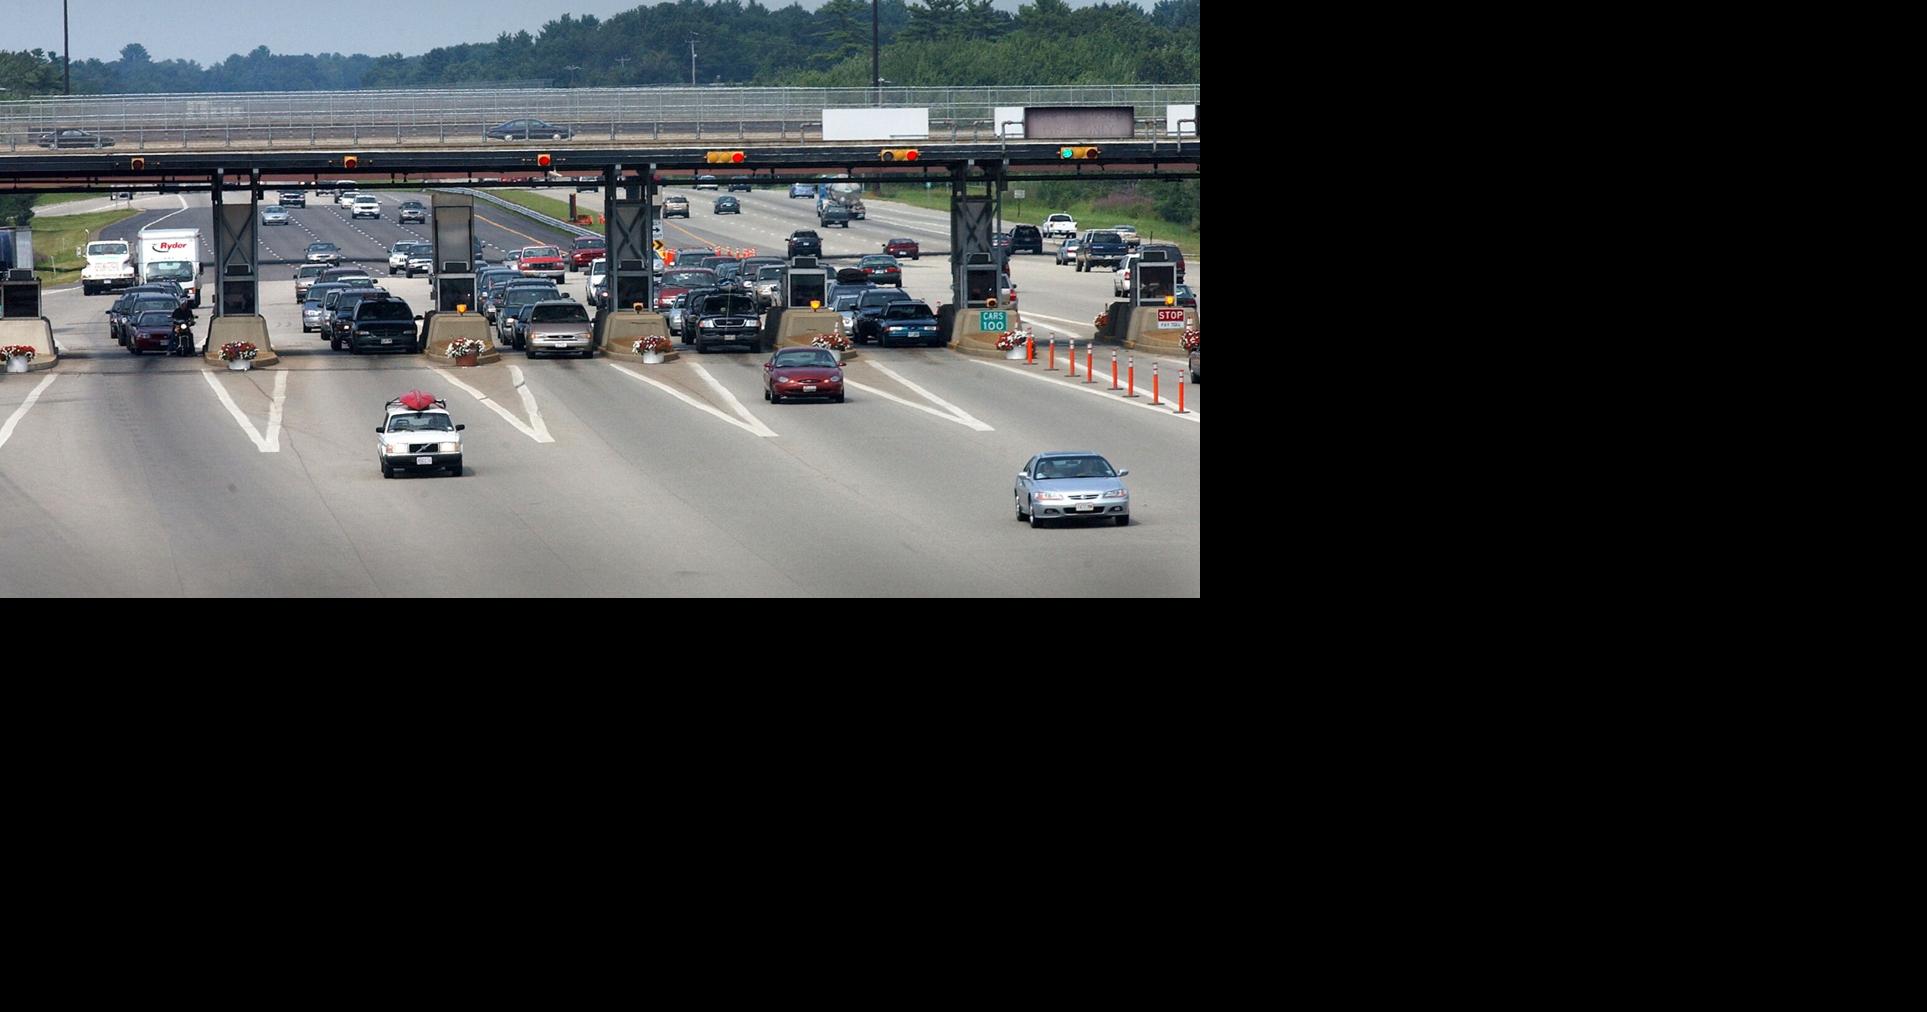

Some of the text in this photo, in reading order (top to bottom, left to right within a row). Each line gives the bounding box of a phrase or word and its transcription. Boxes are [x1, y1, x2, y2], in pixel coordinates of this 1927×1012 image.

[160, 242, 187, 251] Ryder
[983, 312, 1004, 320] CARS
[1159, 310, 1183, 320] STOP
[983, 321, 1004, 330] 100
